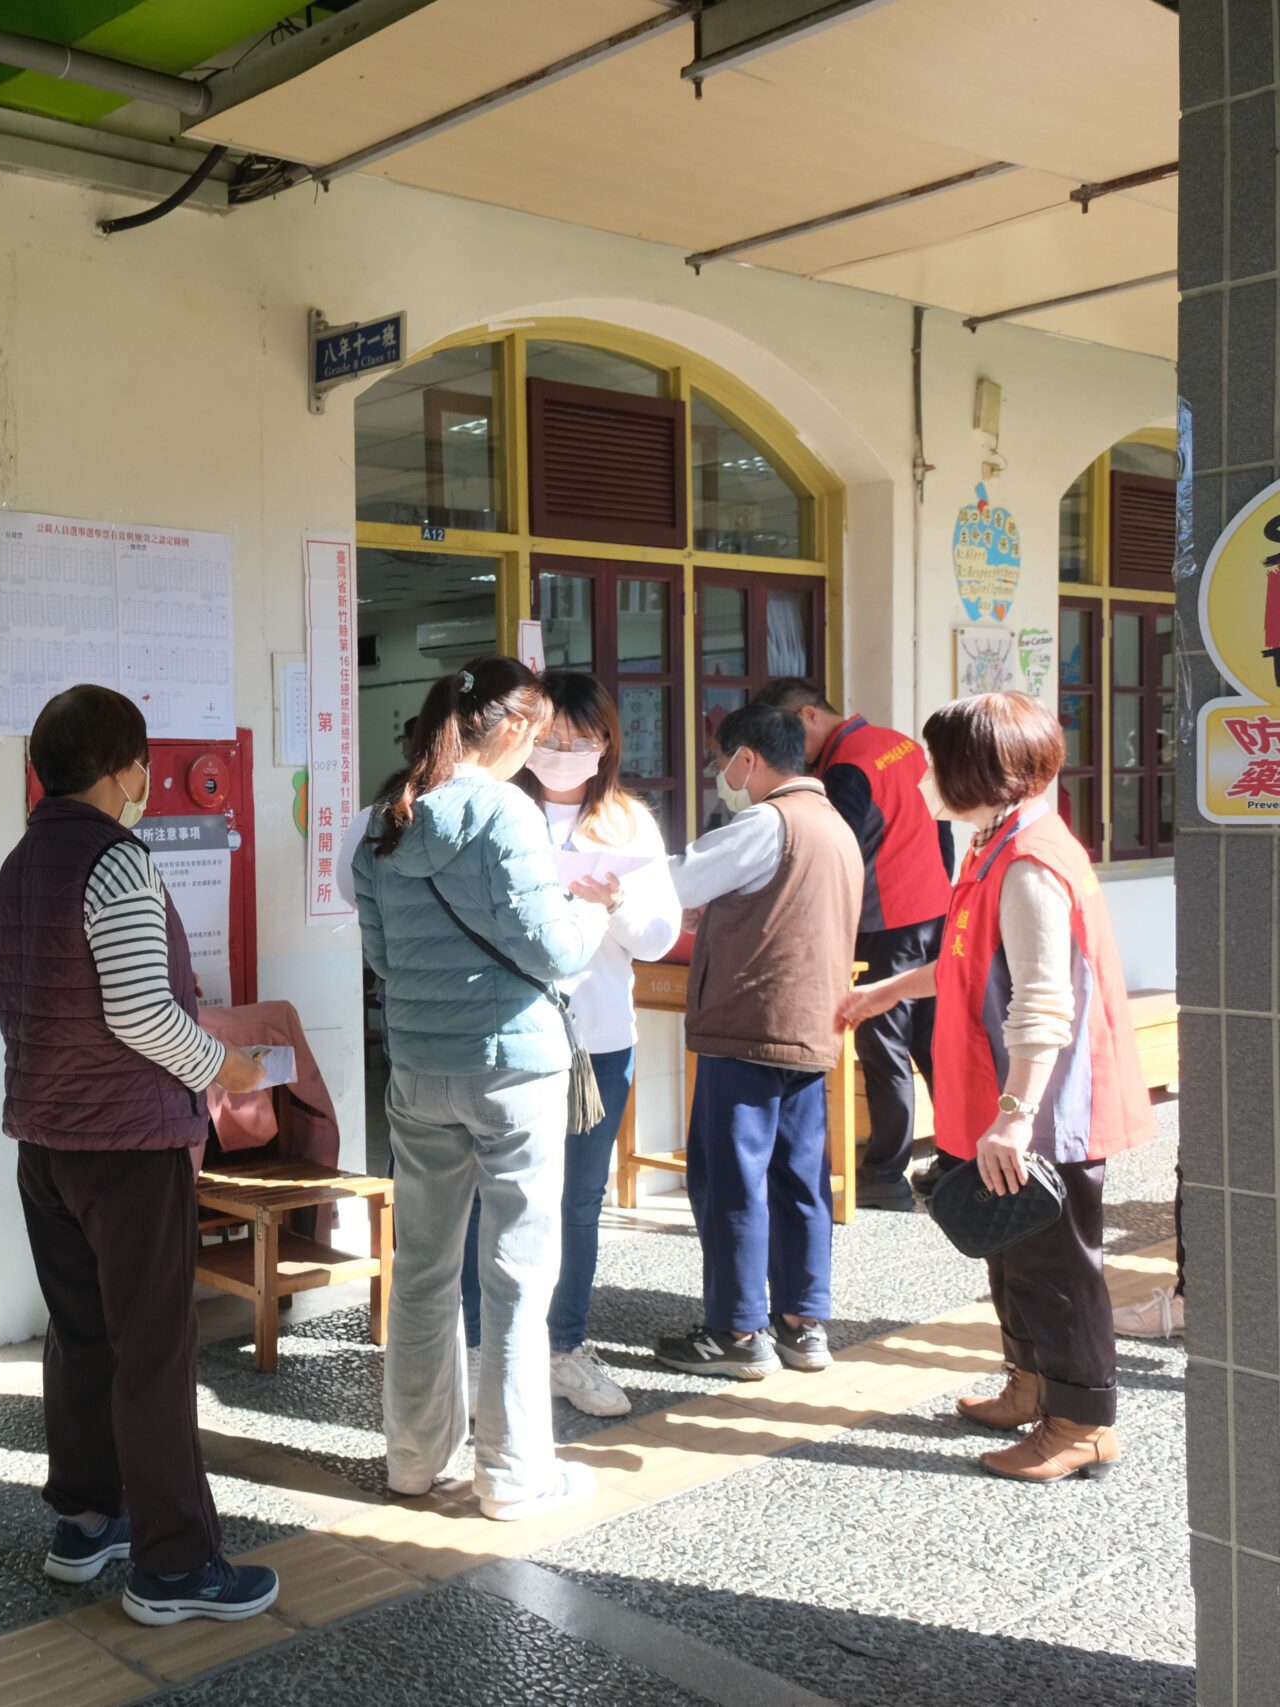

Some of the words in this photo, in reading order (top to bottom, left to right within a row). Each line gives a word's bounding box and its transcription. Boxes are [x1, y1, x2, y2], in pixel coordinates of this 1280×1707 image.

[323, 323, 397, 365] 八年十一班
[324, 362, 352, 377] Grade
[353, 359, 359, 370] 8
[360, 354, 385, 367] Class
[387, 349, 396, 360] 11
[423, 528, 444, 541] A12
[317, 712, 333, 733] 第
[1223, 716, 1280, 755] 防
[1247, 801, 1280, 809] Preve
[317, 807, 333, 903] 投開票所
[649, 980, 671, 993] 100
[693, 1334, 726, 1361] N
